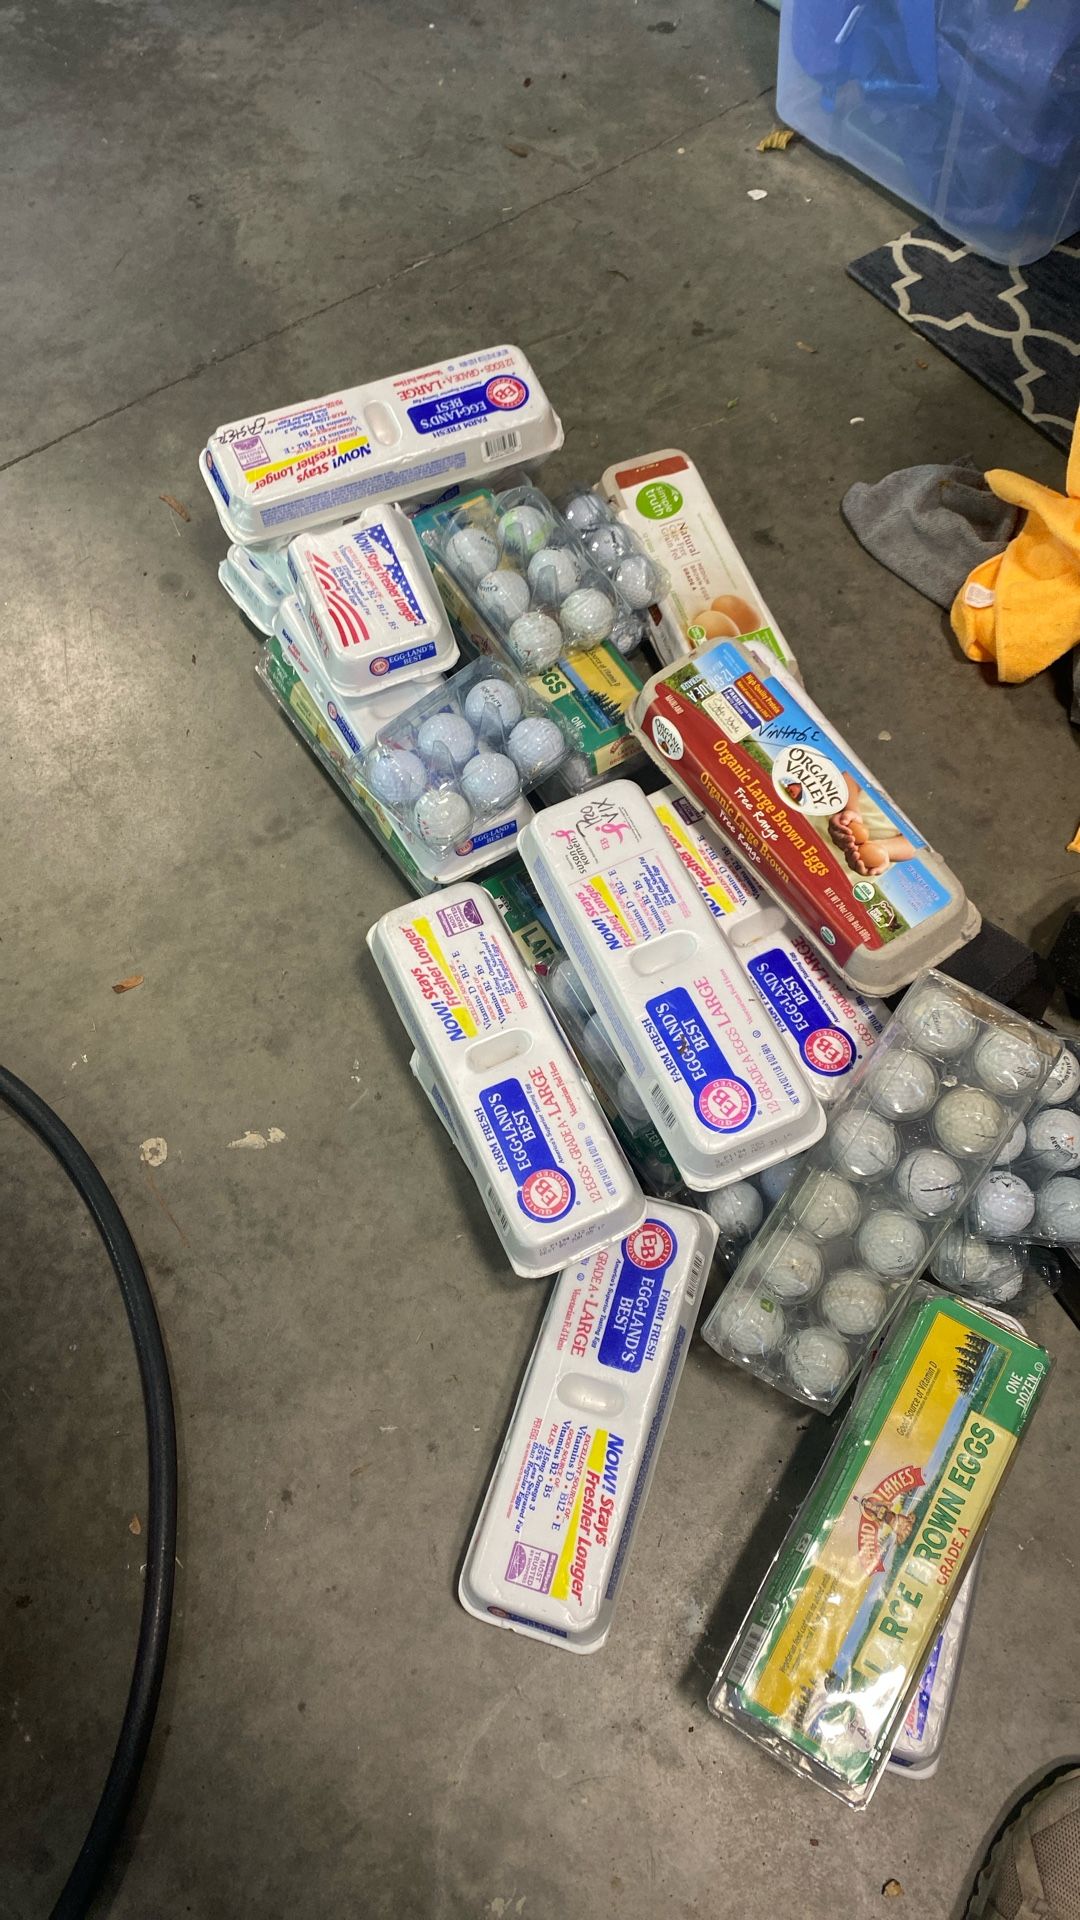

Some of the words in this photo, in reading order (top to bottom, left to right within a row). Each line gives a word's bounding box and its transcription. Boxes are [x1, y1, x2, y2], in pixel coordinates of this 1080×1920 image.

[436, 397, 462, 412] BEST
[433, 424, 460, 438] FRESH
[463, 416, 487, 428] FARM
[296, 446, 337, 471] Fresher
[332, 443, 371, 468] NOW!
[255, 466, 293, 490] Longer
[297, 462, 329, 483] Stays
[645, 488, 664, 517] truth
[655, 486, 672, 512] simple
[660, 527, 674, 548] Grain
[669, 547, 681, 561] Fed
[678, 522, 700, 556] Natural
[352, 532, 375, 553] NOW!
[365, 550, 383, 572] Stays
[377, 569, 401, 597] Fresher
[394, 598, 416, 622] Longer
[403, 654, 421, 665] BEST
[745, 674, 757, 686] High
[754, 684, 768, 699] Quality
[765, 697, 780, 713] Protein
[571, 716, 586, 731] ONE
[786, 760, 826, 804] VALLEY
[789, 748, 842, 805] ORGANIC
[713, 740, 751, 783] Organic
[745, 779, 776, 813] Large
[771, 810, 806, 849] Brown
[801, 846, 829, 876] Eggs
[734, 787, 754, 810] Free
[751, 811, 779, 841] Range
[700, 771, 736, 815] Organic
[729, 812, 762, 846] Large
[759, 843, 790, 883] Brown
[718, 809, 735, 833] Free
[737, 833, 761, 863] Range
[599, 838, 610, 850] EB
[705, 847, 718, 860] B12
[608, 868, 616, 876] E
[679, 851, 715, 887] Fresher
[719, 866, 727, 874] D
[582, 884, 609, 914] Longer
[615, 881, 627, 895] B12
[633, 880, 643, 890] B5
[726, 874, 747, 905] Vitamins
[575, 892, 598, 917] Stays
[625, 900, 634, 908] D
[641, 895, 651, 905] B2
[605, 914, 635, 947] Fresher
[632, 909, 651, 940] Vitamins
[649, 905, 666, 933] Vitamins
[402, 928, 433, 965] Longer
[592, 918, 622, 950] NOW!
[452, 949, 460, 957] E
[794, 939, 825, 982] LARGE
[411, 968, 438, 1000] Stays
[458, 964, 470, 979] B12
[475, 964, 484, 975] B5
[427, 966, 460, 1006] Fresher
[468, 986, 476, 994] D
[483, 981, 492, 991] B2
[781, 976, 809, 1005] BEST
[828, 983, 838, 992] A
[473, 995, 492, 1029] Vitamins
[489, 992, 506, 1023] Vitamins
[693, 976, 731, 1028] LARGE
[832, 990, 856, 1019] GRADE
[431, 1002, 466, 1041] NOW!
[641, 1018, 665, 1052] FRESH
[681, 1019, 709, 1052] BEST
[856, 1023, 875, 1047] EGGS
[725, 1027, 748, 1055] EGGS
[816, 1038, 840, 1062] EB
[660, 1053, 682, 1082] FARM
[742, 1054, 753, 1063] A
[528, 1066, 561, 1117] LARGE
[747, 1064, 771, 1099] GRADE
[701, 1096, 731, 1127] QUALITY
[712, 1089, 737, 1117] EB
[474, 1107, 495, 1141] FRESH
[511, 1109, 536, 1142] BEST
[557, 1120, 568, 1128] A
[489, 1142, 508, 1172] FARM
[560, 1128, 582, 1160] GRADE
[577, 1164, 597, 1189] EGGS
[523, 1185, 549, 1216] QUALITY
[535, 1179, 558, 1206] EB
[589, 1190, 602, 1203] 12
[641, 1233, 657, 1259] EB
[656, 1227, 671, 1265] QUALITY
[591, 1251, 609, 1284] GRADE
[588, 1284, 598, 1292] A
[613, 1296, 633, 1334] BEST
[655, 1289, 670, 1320] FARM
[571, 1300, 598, 1357] LARGE
[645, 1323, 662, 1361] FRESH
[918, 1367, 935, 1390] Vitamin
[928, 1360, 937, 1369] D
[914, 1388, 924, 1398] of
[1006, 1372, 1023, 1394] ONE
[1014, 1373, 1038, 1408] DOZEN
[904, 1397, 920, 1419] Source
[529, 1442, 539, 1459] than
[535, 1444, 544, 1461] 25%
[554, 1421, 570, 1459] Vitamins
[568, 1426, 587, 1468] Vitamins
[529, 1462, 539, 1479] Less
[548, 1462, 558, 1475] B2
[601, 1433, 624, 1494] NOW!
[947, 1422, 995, 1491] EGGS
[520, 1460, 533, 1489] Regular
[565, 1471, 574, 1481] D
[878, 1469, 914, 1497] LAKES
[514, 1491, 524, 1510] Eggs
[519, 1481, 534, 1518] Saturated
[542, 1484, 552, 1498] B5
[556, 1492, 568, 1512] B12
[578, 1470, 599, 1535] Fresher
[514, 1519, 523, 1533] Fat
[551, 1522, 560, 1531] E
[594, 1494, 614, 1546] Stays
[526, 1552, 541, 1586] TRUSTED
[535, 1559, 546, 1581] MOST
[570, 1536, 591, 1600] Longer
[936, 1537, 965, 1586] GRADE
[956, 1526, 970, 1538] A
